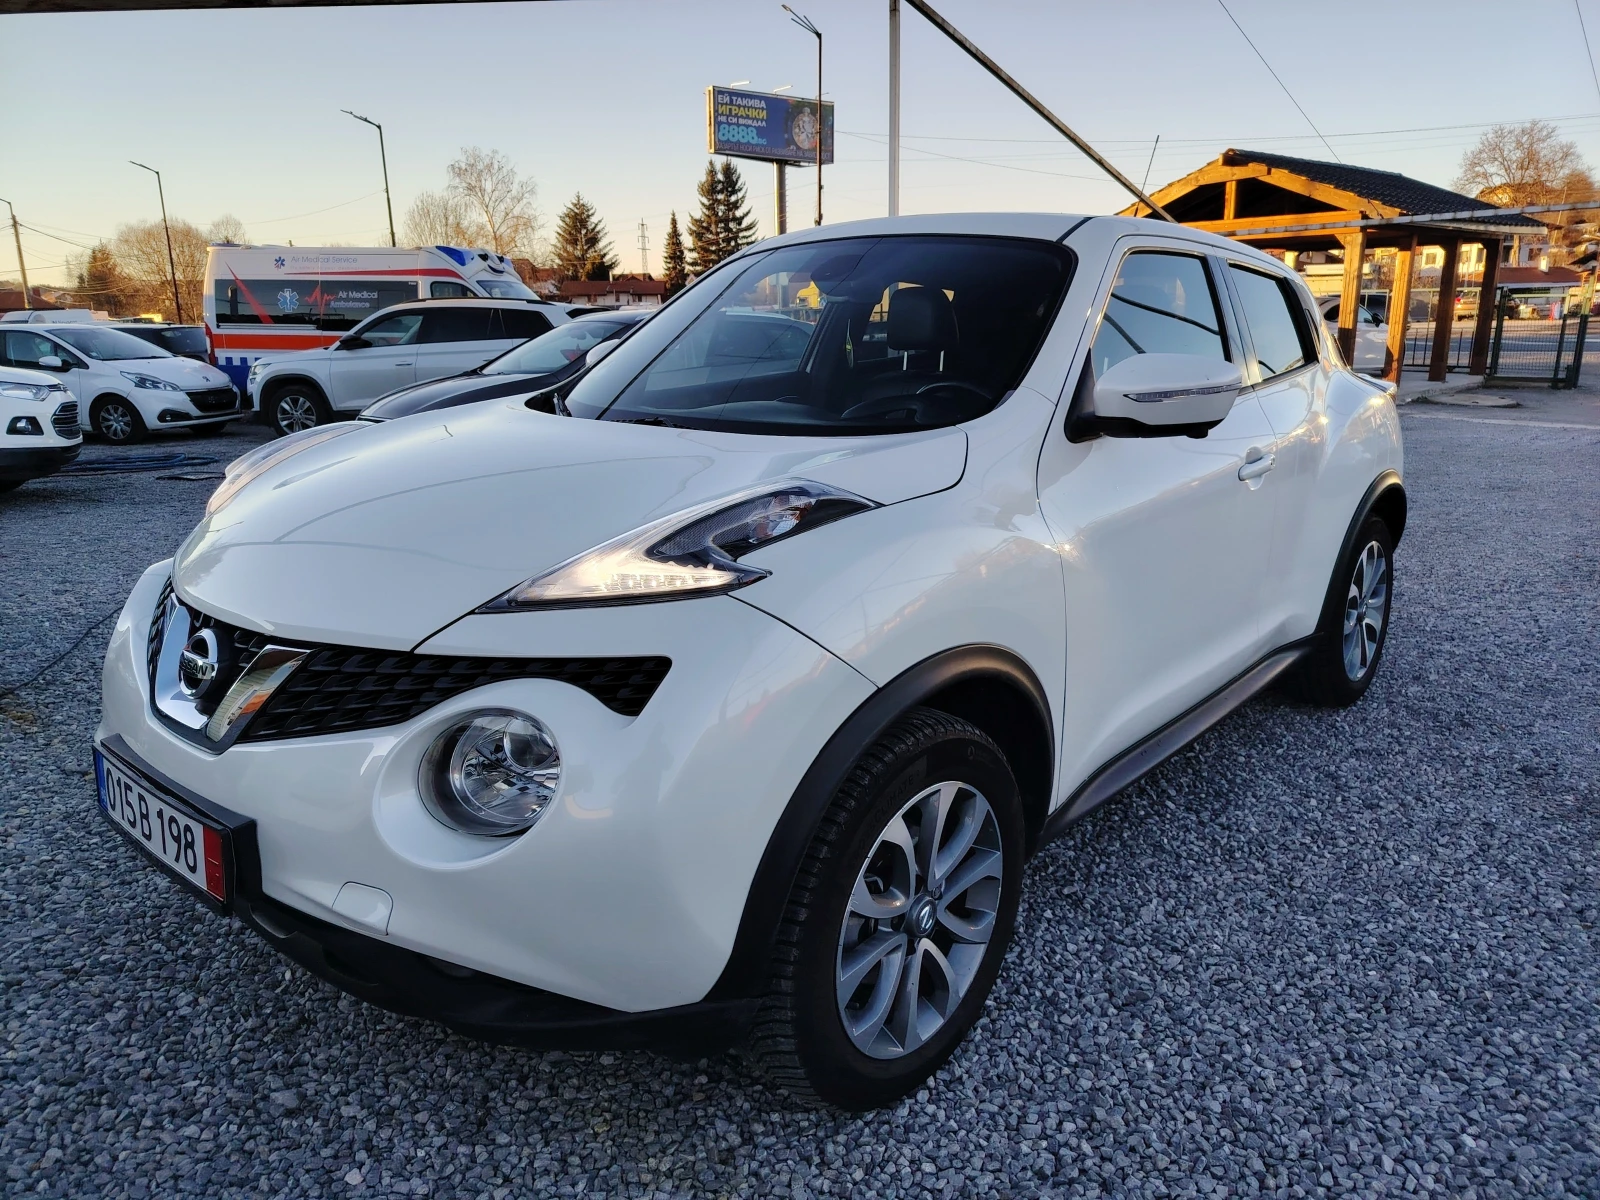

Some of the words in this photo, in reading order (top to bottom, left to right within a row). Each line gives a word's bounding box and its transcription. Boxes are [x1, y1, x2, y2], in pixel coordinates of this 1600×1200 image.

[717, 94, 729, 104] ЕЙ
[731, 96, 766, 109] ТАКИВА
[718, 104, 767, 119] ИГРАЧКИ
[738, 118, 767, 127] ВИЖДАЛ
[302, 256, 330, 264] Medical
[338, 291, 348, 299] Air
[349, 290, 378, 299] Medical
[329, 300, 370, 308] Ambulance
[180, 657, 209, 677] SSAN
[157, 806, 198, 874] 198
